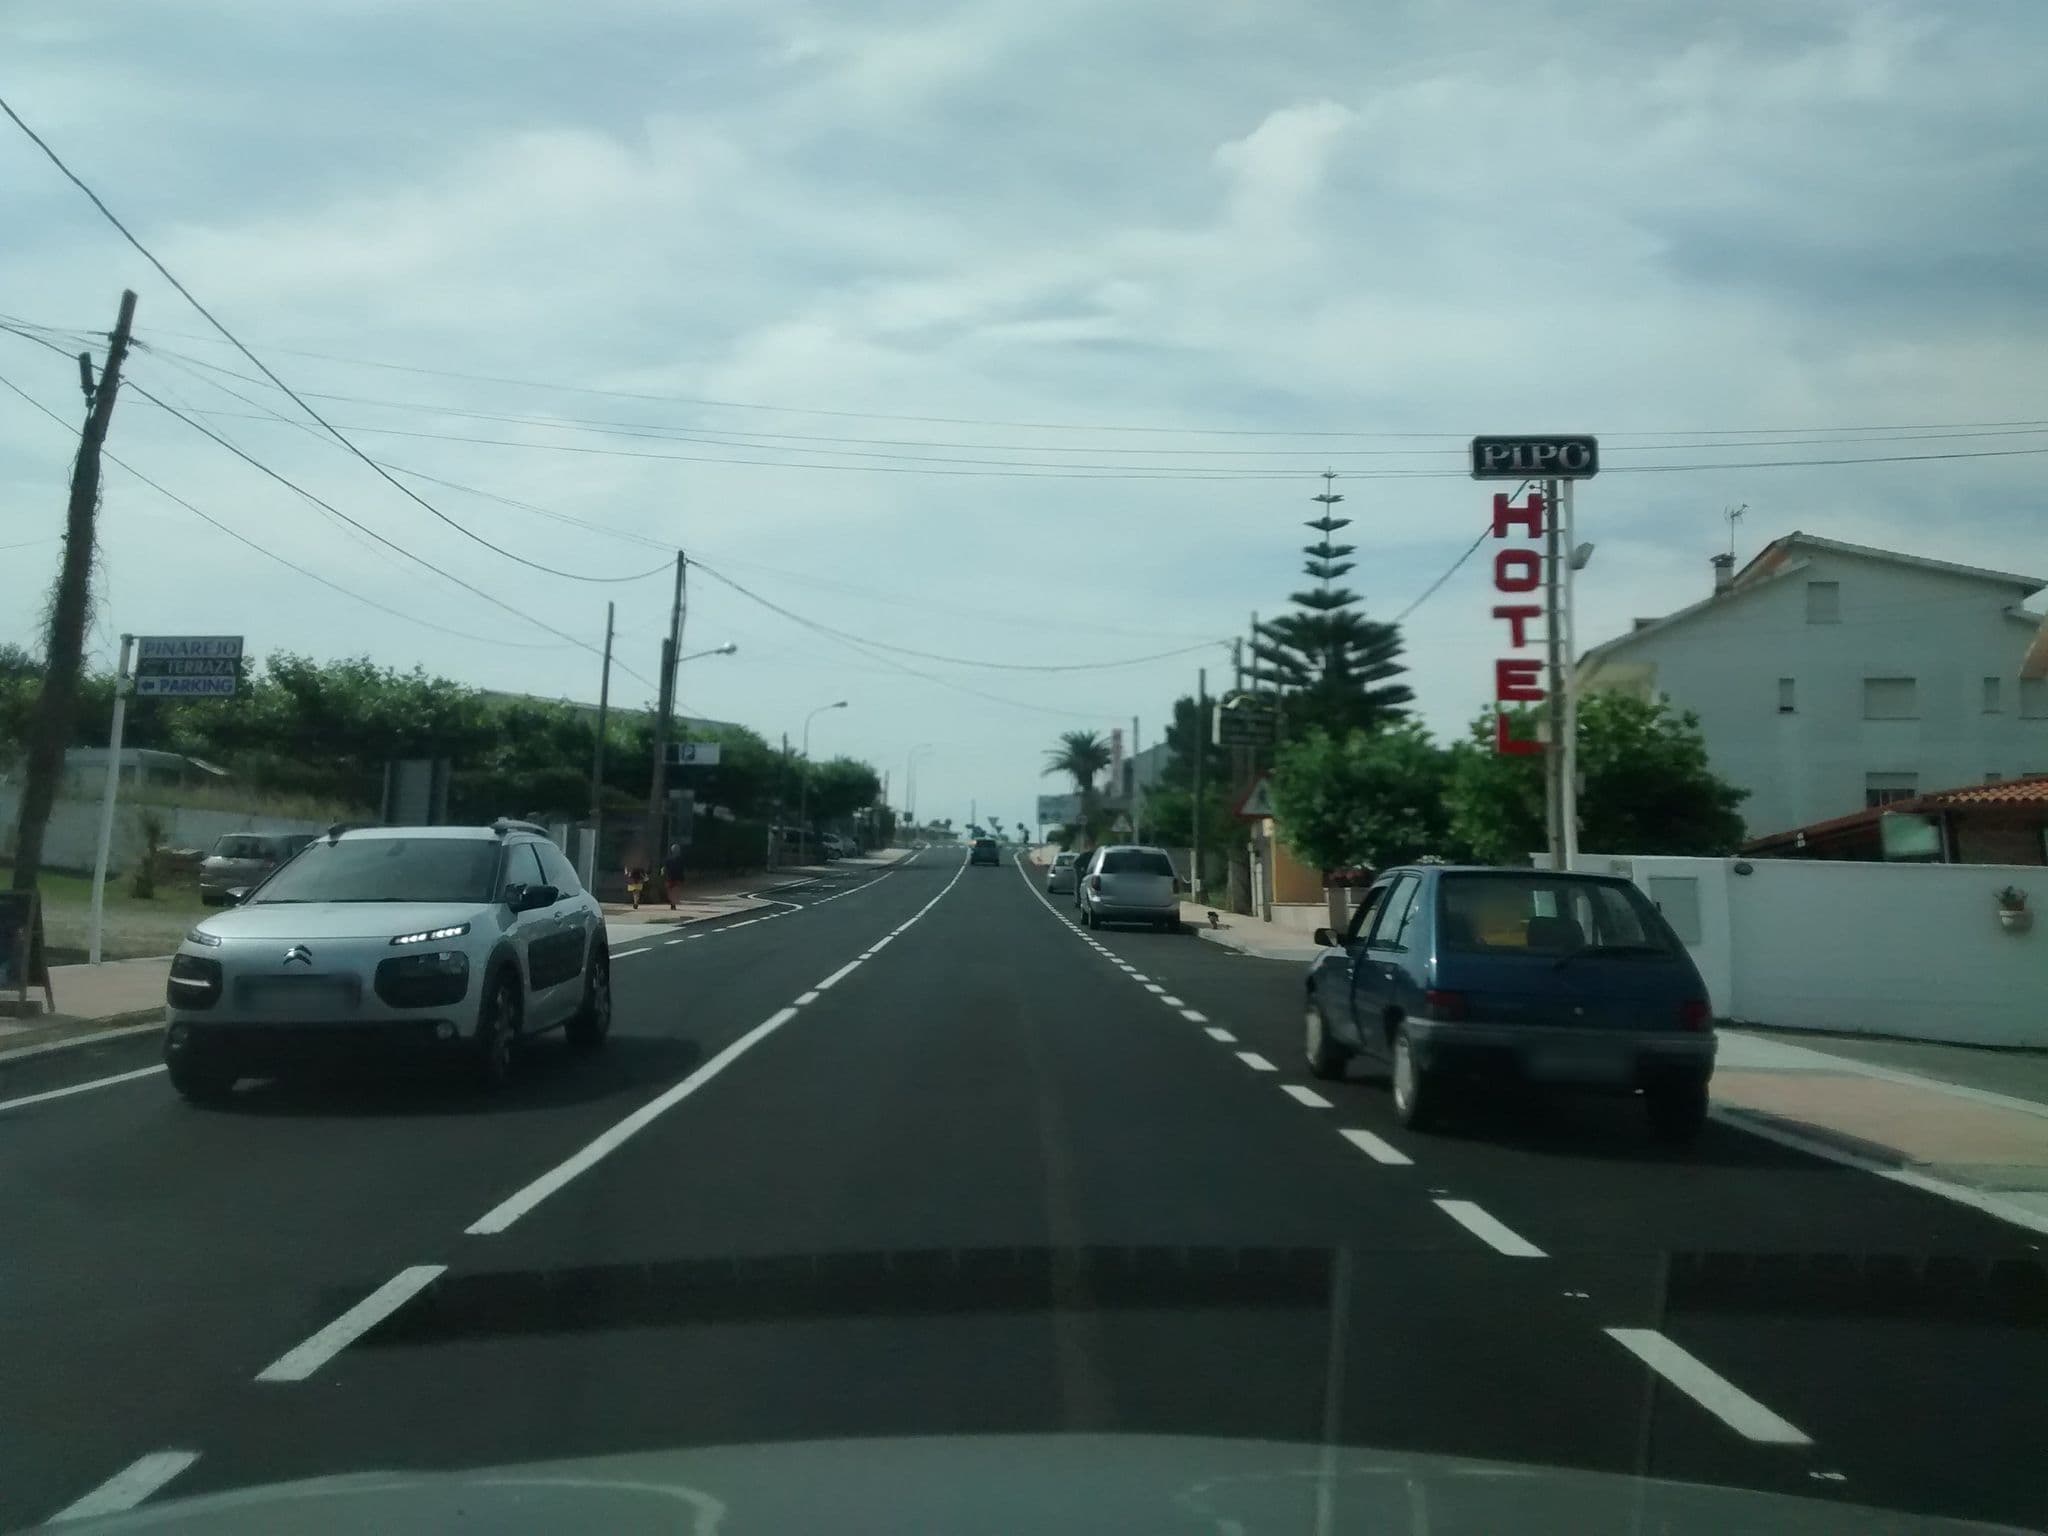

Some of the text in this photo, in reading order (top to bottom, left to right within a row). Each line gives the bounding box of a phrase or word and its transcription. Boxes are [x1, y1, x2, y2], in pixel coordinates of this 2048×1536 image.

[1481, 442, 1591, 470] PIPO
[1492, 493, 1545, 755] HOTEL
[143, 640, 238, 656] PINAREJO
[166, 659, 235, 674] TERRAZA
[159, 678, 233, 693] PARKING
